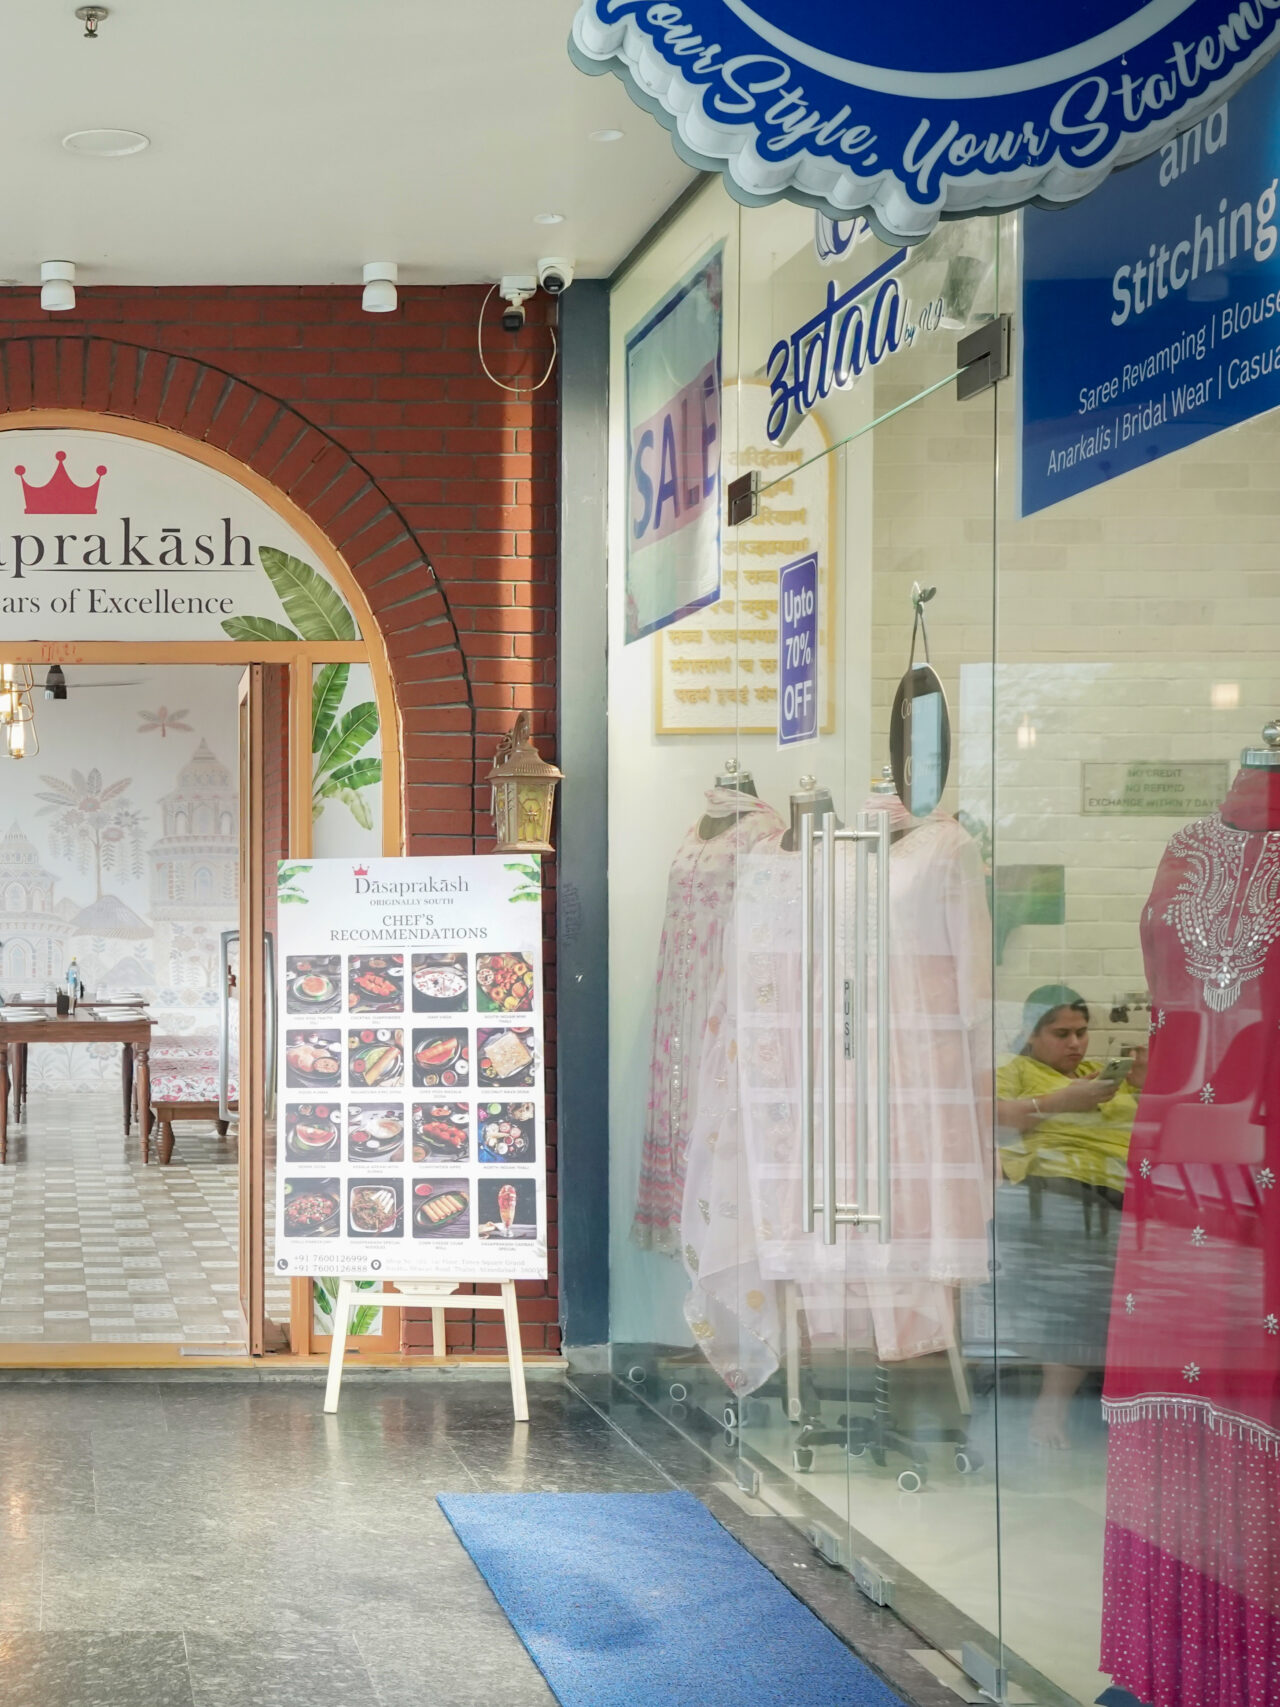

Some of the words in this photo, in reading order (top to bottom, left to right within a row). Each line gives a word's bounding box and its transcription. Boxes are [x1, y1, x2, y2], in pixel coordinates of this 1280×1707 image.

[607, 0, 723, 74] our
[714, 54, 878, 167] Style,
[902, 118, 1049, 194] Your
[1049, 0, 1280, 157] Statem
[1159, 102, 1228, 187] and
[1111, 178, 1278, 326] Stitching
[1078, 377, 1119, 415] Saree
[1122, 325, 1206, 392] Revamping
[1047, 425, 1111, 476] Anarkalis
[1122, 393, 1168, 441] Bridal
[1171, 377, 1213, 417] Wear
[1227, 345, 1280, 389] Casua
[633, 374, 716, 540] SALE
[50, 587, 81, 614] of
[88, 587, 234, 614] Excellence
[784, 585, 814, 629] Upto
[785, 631, 811, 670] 70%
[784, 680, 812, 721] OFF
[354, 875, 469, 897] Dāsaprakāsh
[369, 898, 422, 907] ORIGINALLY
[423, 897, 454, 905] SOUTH
[330, 927, 488, 942] RECOMMENDATIONS
[382, 914, 434, 927] CHEF'S
[843, 981, 851, 1057] PUSH
